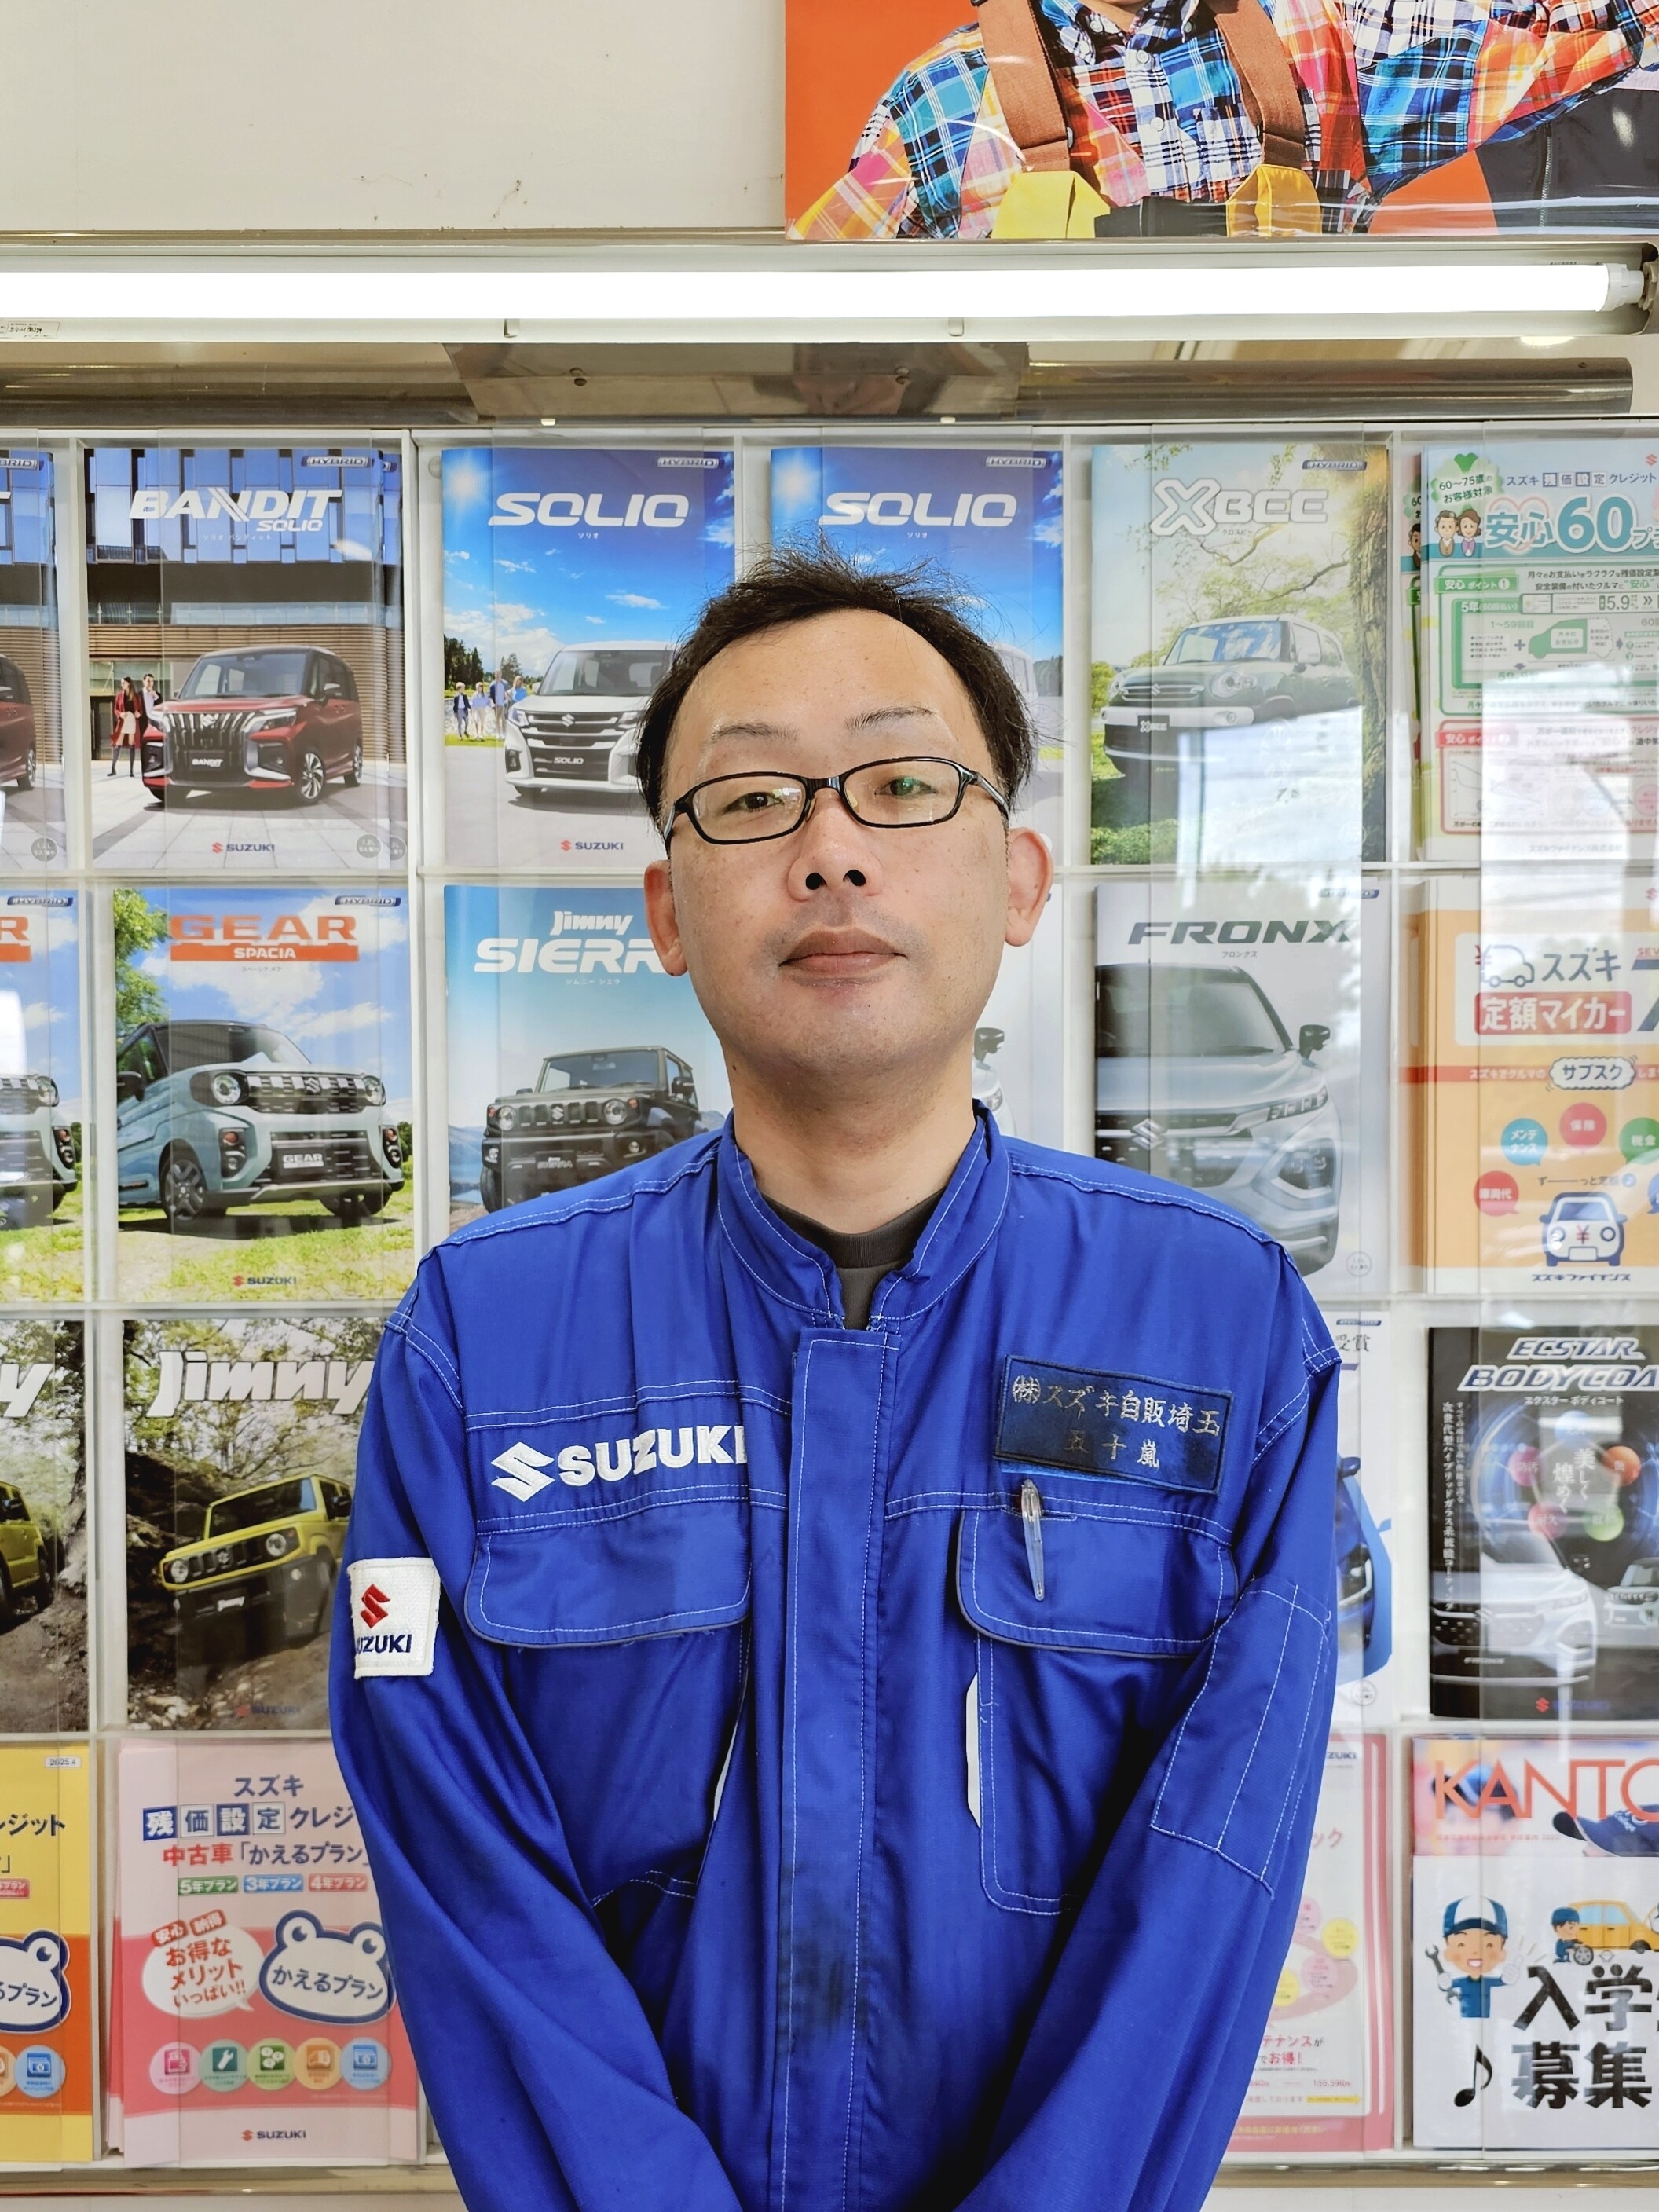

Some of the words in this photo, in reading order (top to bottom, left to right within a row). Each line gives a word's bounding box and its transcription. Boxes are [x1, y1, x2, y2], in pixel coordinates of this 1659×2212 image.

[130, 488, 342, 522] BANDIT
[488, 493, 689, 527] SOLIO
[819, 493, 1017, 527] SOLIO
[256, 520, 323, 532] SOLIO
[226, 843, 275, 853] SUZUKI
[575, 842, 624, 851] SUZUKI
[168, 915, 357, 940] GEAR
[550, 911, 633, 936] Jimny
[1128, 920, 1358, 945] FRONX
[233, 947, 297, 959] SPACIA
[1541, 947, 1621, 982] スズキ
[1481, 996, 1627, 1031] 定額マイカー
[1562, 1064, 1624, 1081] サブスク
[1531, 1273, 1632, 1282] スズキファイナンス
[1507, 1336, 1646, 1361] ECSTAR
[146, 1351, 375, 1417] Jimny
[1524, 1396, 1568, 1406] エクスター
[558, 1425, 746, 1486] SUZUKI
[1574, 1448, 1597, 1501] 美しく
[356, 1634, 412, 1654] UZUKI
[1328, 1751, 1357, 1760] ZUKI
[234, 1774, 304, 1797] スズキ
[146, 1804, 353, 1837] 残価設定クレジ
[179, 1877, 237, 1894] 5年プラン
[245, 1877, 303, 1892] 3年プラン
[309, 1875, 366, 1891] 4年プラン
[165, 1937, 233, 1967] お得な
[170, 1958, 244, 1990] メリット
[272, 1965, 384, 2000] かえるプラン
[1512, 1964, 1659, 2031] 入学
[1511, 2040, 1653, 2109] 募集
[257, 2130, 306, 2139] SUZUKI
